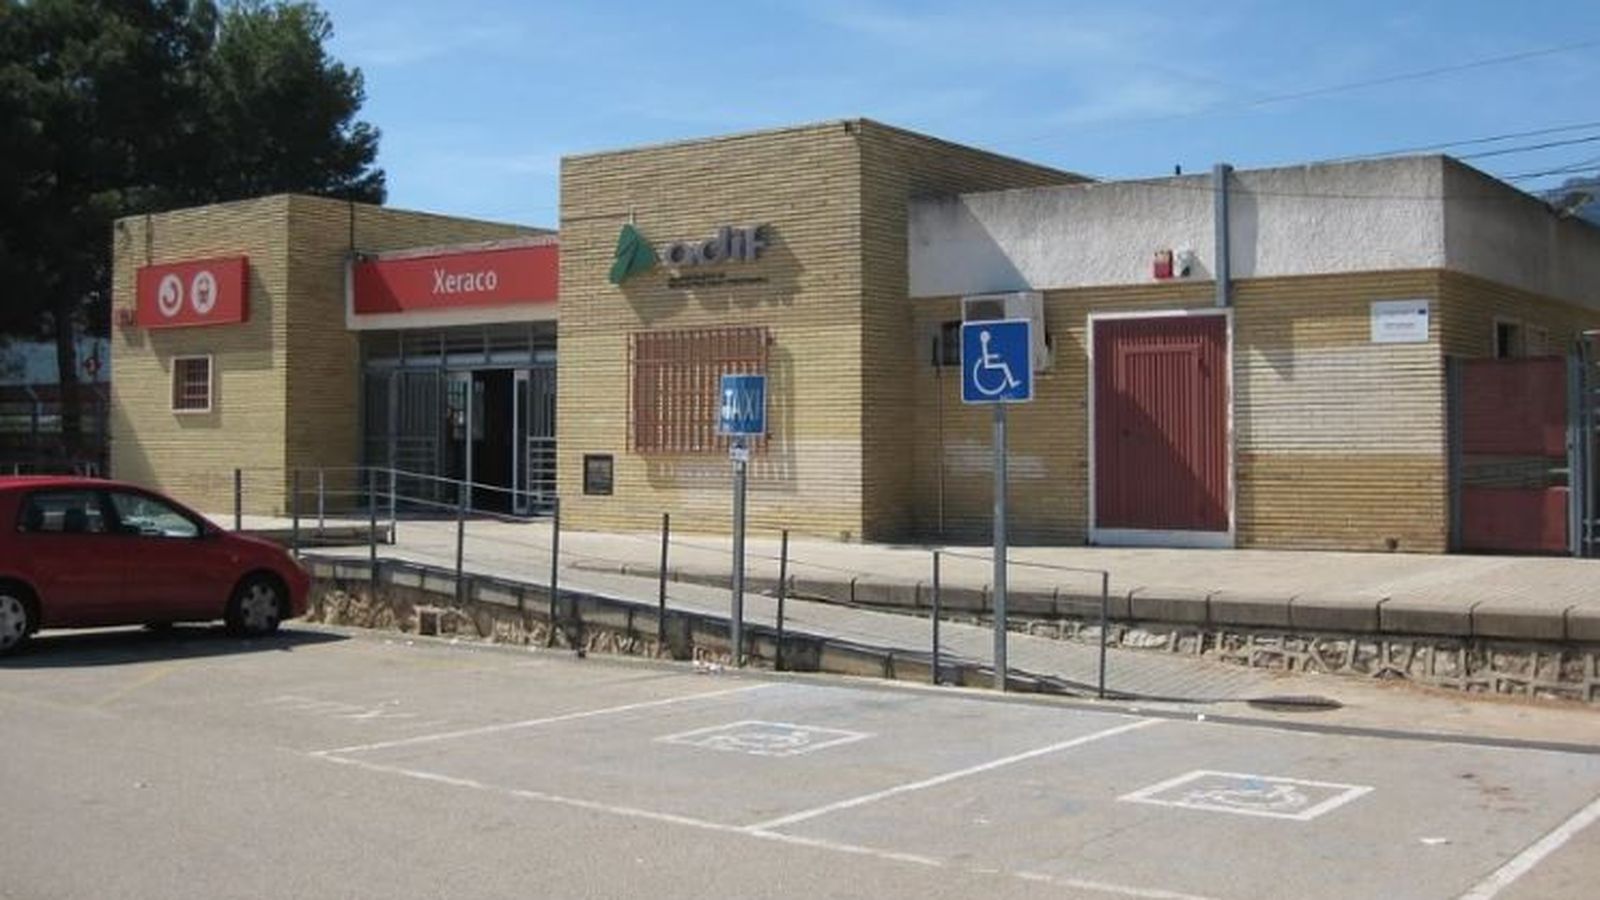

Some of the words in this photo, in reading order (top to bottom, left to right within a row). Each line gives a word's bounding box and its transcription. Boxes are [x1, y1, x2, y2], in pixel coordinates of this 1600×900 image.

[665, 225, 770, 265] adif
[432, 268, 498, 295] Xeraco
[723, 388, 762, 421] TAXI
